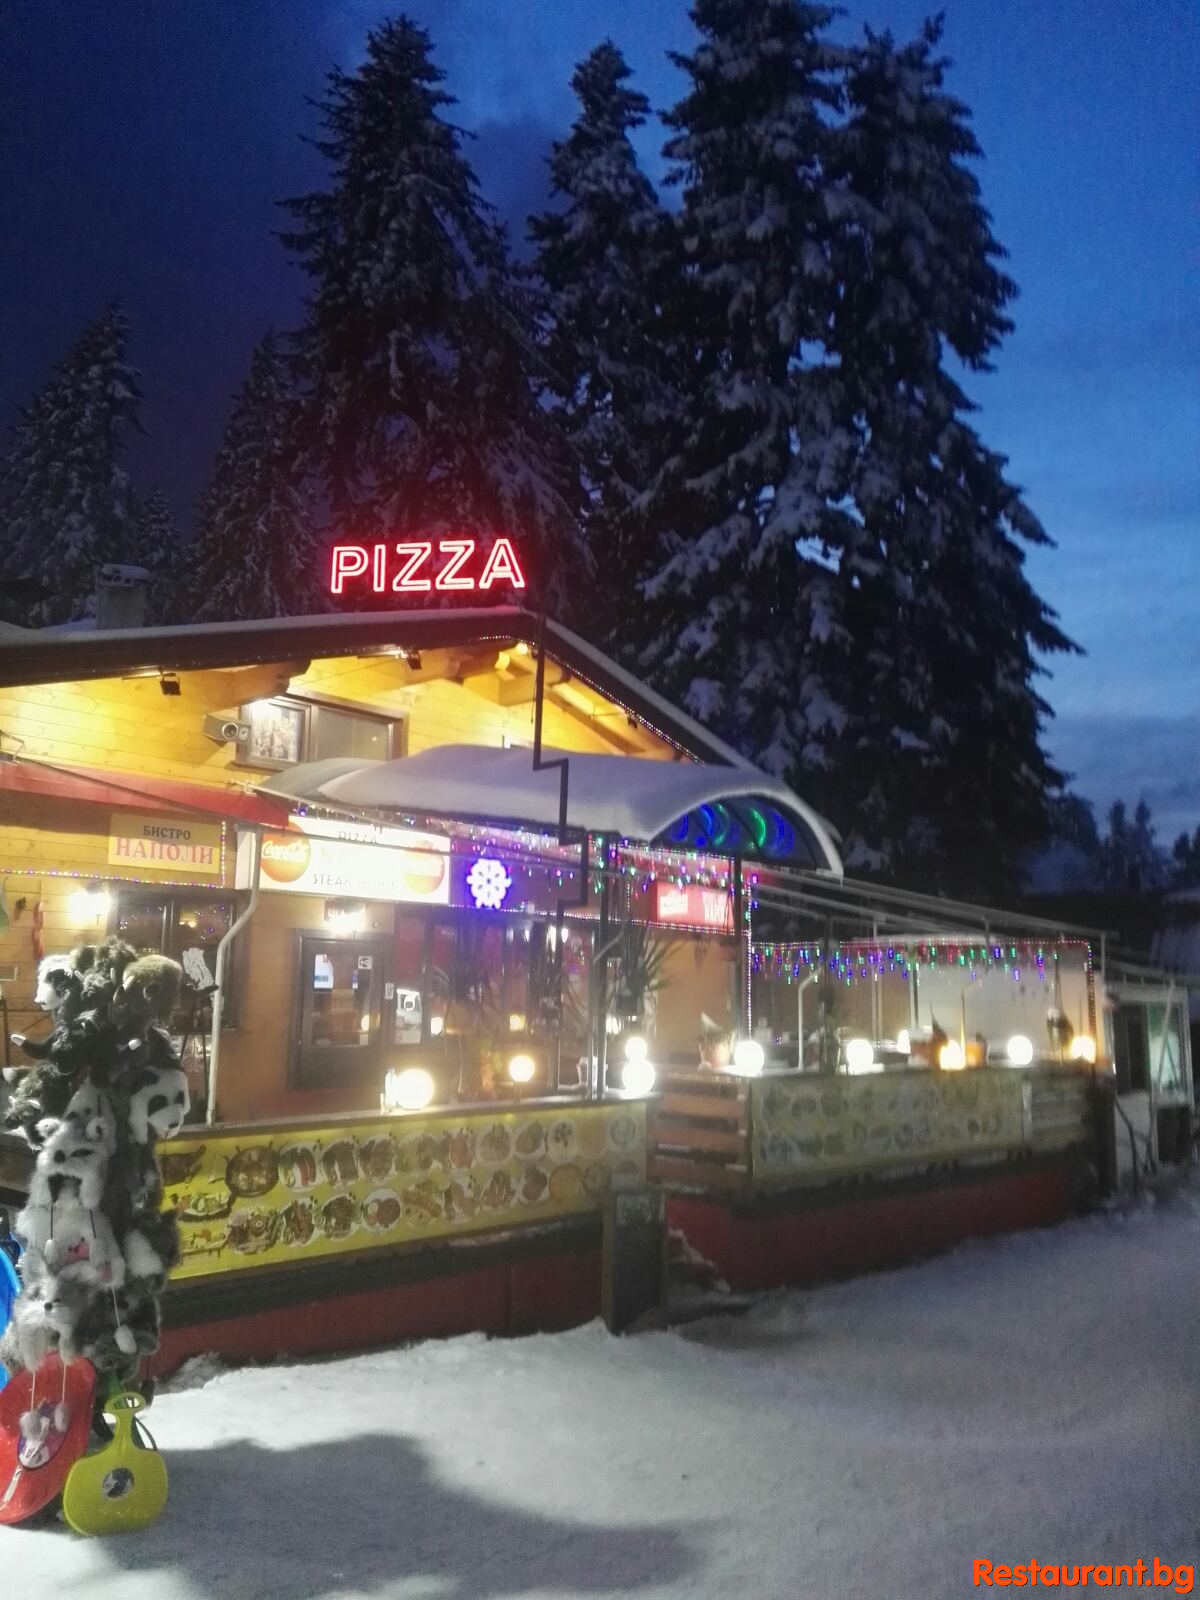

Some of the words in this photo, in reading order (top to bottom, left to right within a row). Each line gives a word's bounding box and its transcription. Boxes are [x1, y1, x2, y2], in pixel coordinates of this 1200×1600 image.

[331, 539, 526, 593] PIZZA
[143, 825, 191, 841] БИСТРО
[115, 836, 214, 865] НАПОЛИ
